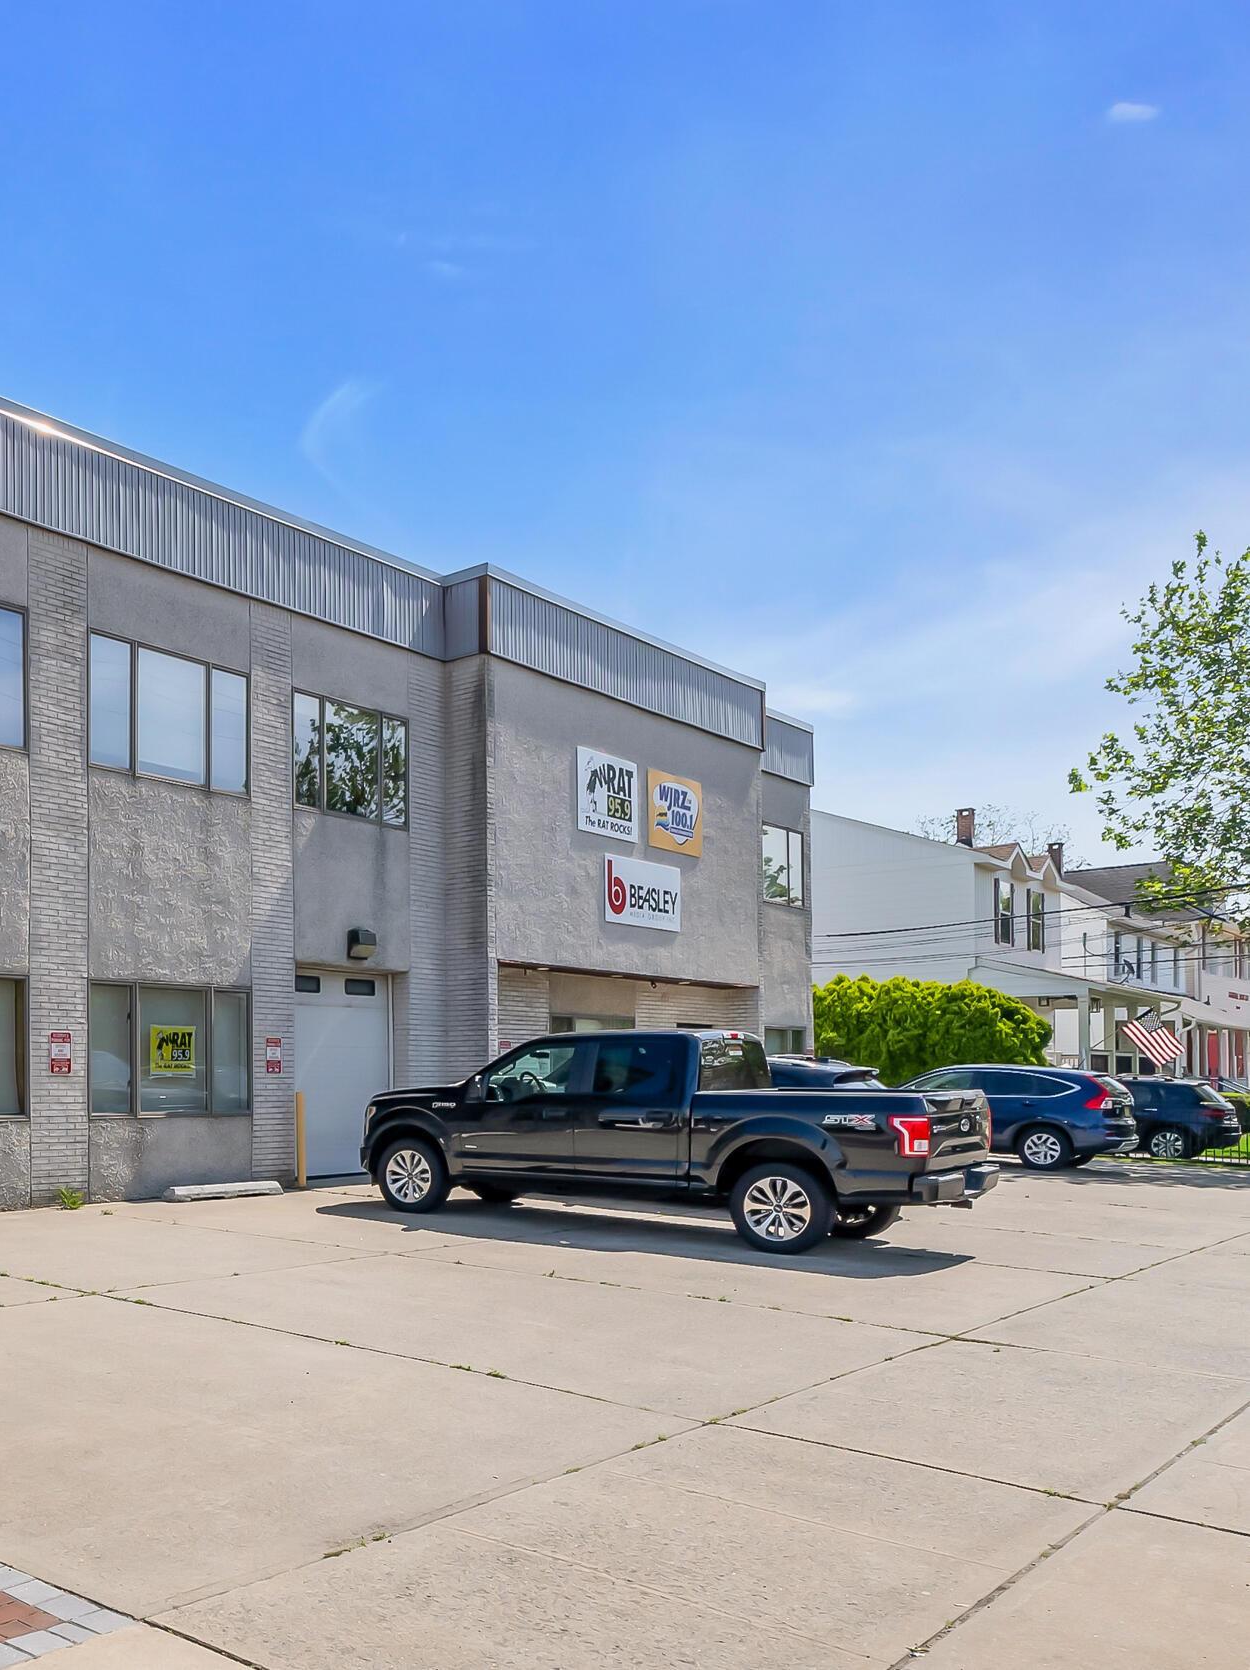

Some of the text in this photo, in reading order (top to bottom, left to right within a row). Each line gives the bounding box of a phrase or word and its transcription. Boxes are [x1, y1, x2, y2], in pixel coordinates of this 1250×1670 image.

[659, 784, 691, 811] WJRZ
[608, 797, 631, 820] 95.9
[585, 816, 632, 835] The RAT ROCKS!
[671, 810, 693, 830] 100.1
[630, 884, 678, 915] BEASLEY
[172, 1050, 190, 1060] 95.9
[822, 1114, 876, 1127] STX
